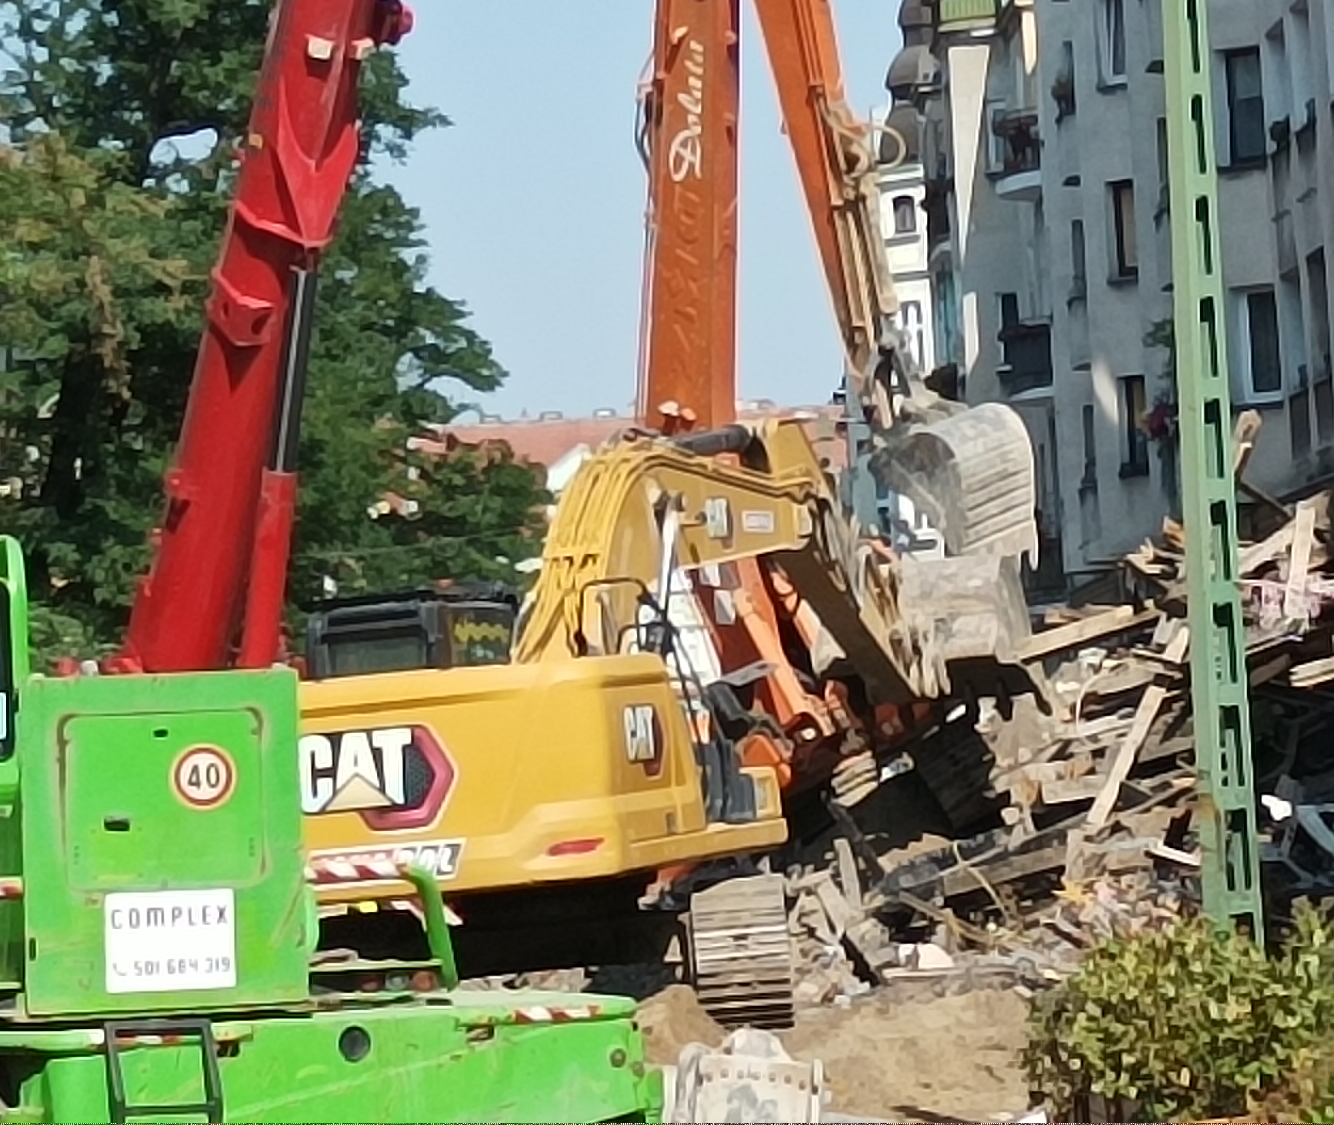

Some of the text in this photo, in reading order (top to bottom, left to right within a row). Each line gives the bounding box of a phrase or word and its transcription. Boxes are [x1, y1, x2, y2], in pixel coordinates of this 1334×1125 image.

[624, 706, 655, 761] CAT
[187, 762, 220, 790] 40
[297, 727, 413, 813] CAT
[111, 904, 228, 930] COMPLEX
[133, 960, 160, 977] 501
